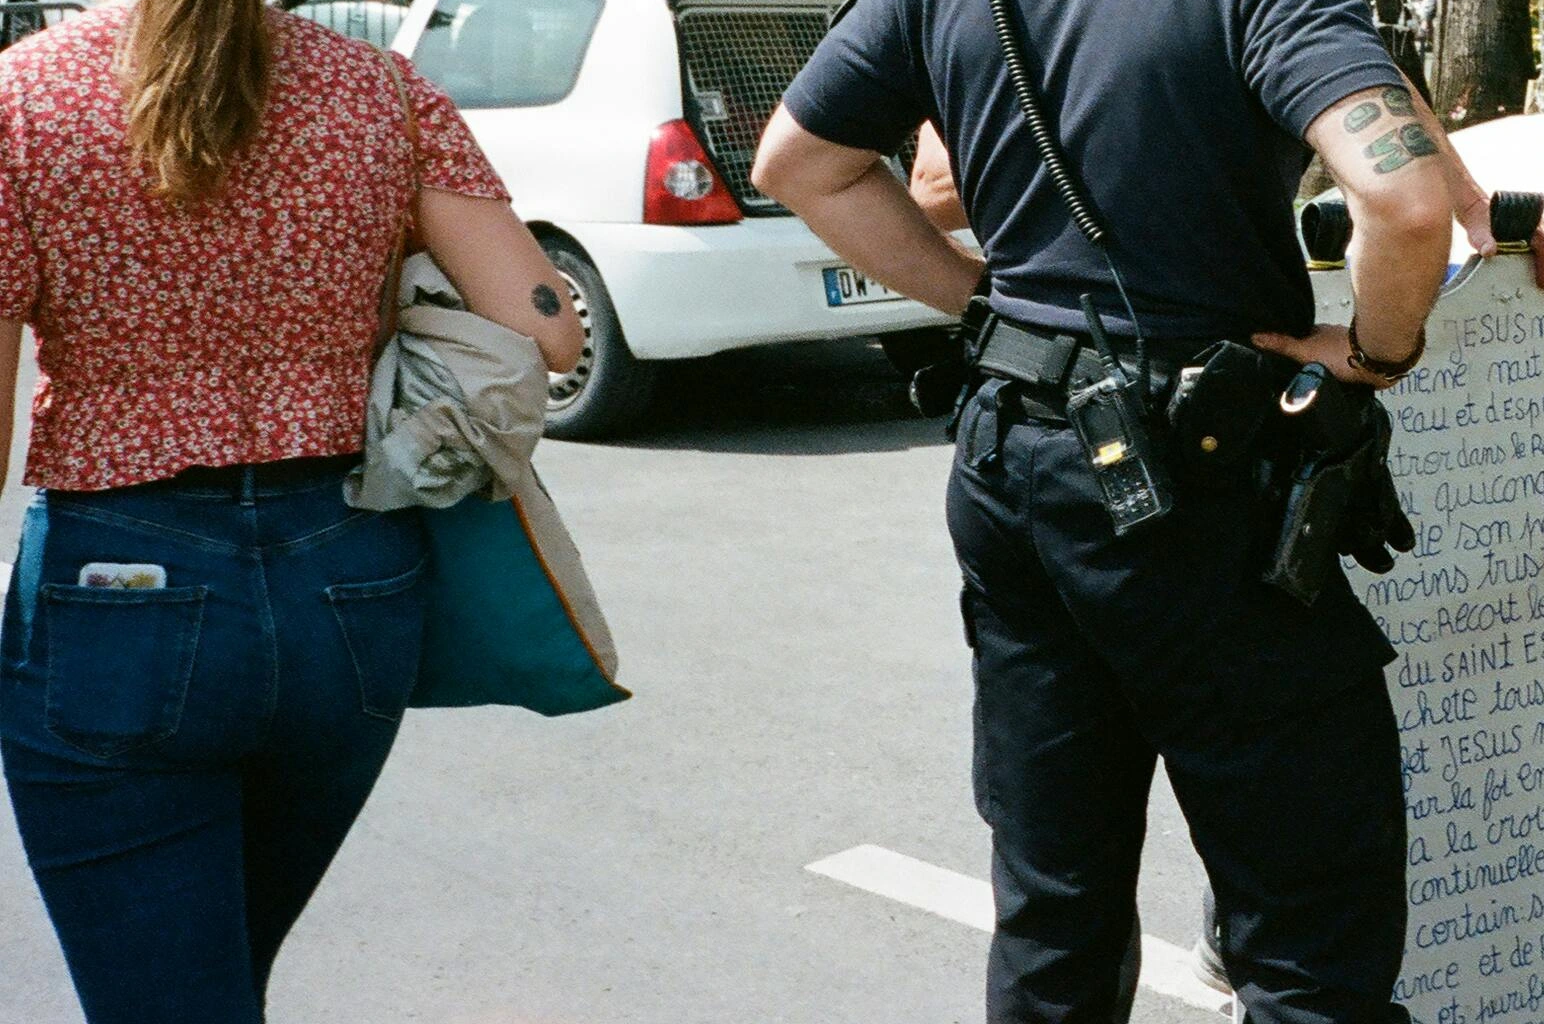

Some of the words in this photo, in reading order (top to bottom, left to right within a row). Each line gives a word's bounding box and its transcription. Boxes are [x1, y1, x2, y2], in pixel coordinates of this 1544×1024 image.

[1442, 312, 1526, 364] JESUS
[1456, 392, 1480, 427] et
[1454, 520, 1512, 551] son
[1365, 563, 1469, 607] moins
[1440, 724, 1523, 783] JESUS
[1478, 943, 1504, 978] et
[1509, 934, 1534, 968] de
